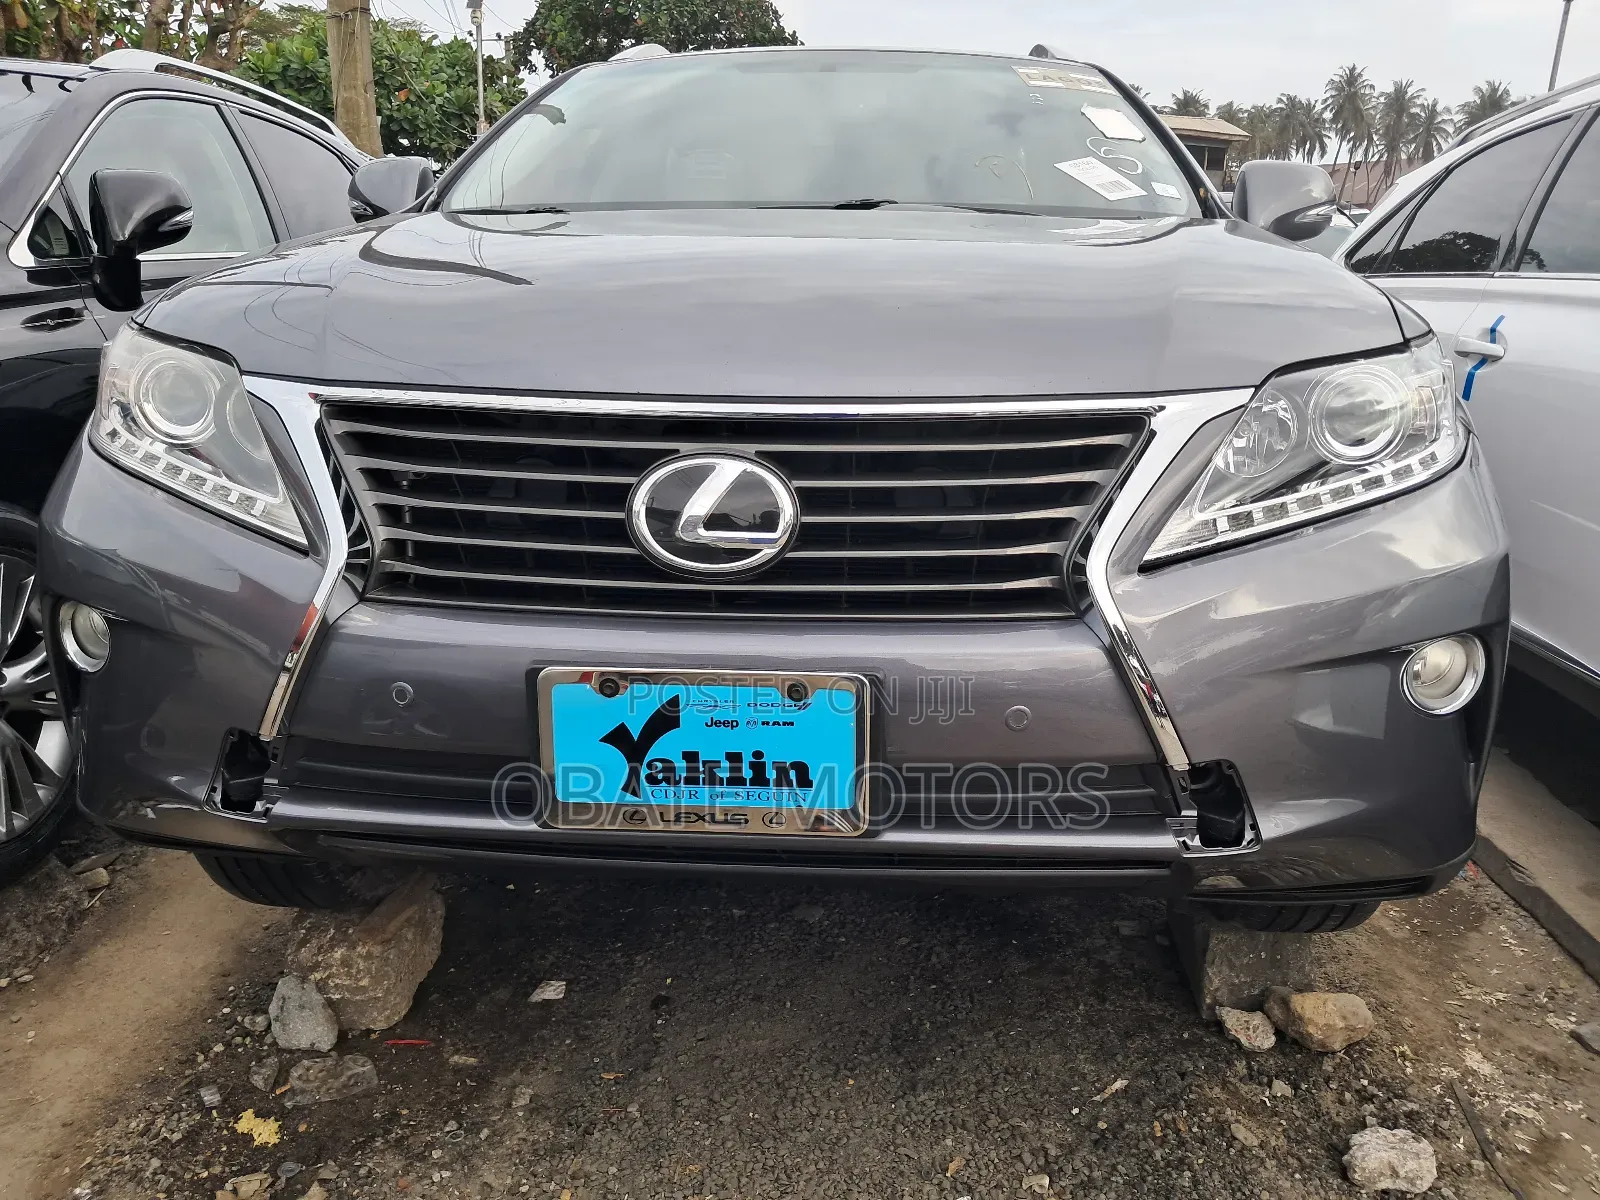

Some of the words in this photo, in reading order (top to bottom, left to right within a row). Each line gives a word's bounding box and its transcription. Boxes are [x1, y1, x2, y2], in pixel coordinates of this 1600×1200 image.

[746, 701, 806, 710] DODGE
[704, 716, 740, 731] Jeep
[650, 788, 700, 800] CDJR
[709, 789, 727, 801] of
[734, 789, 808, 803] SEGUIN
[659, 811, 750, 825] LEXUS
